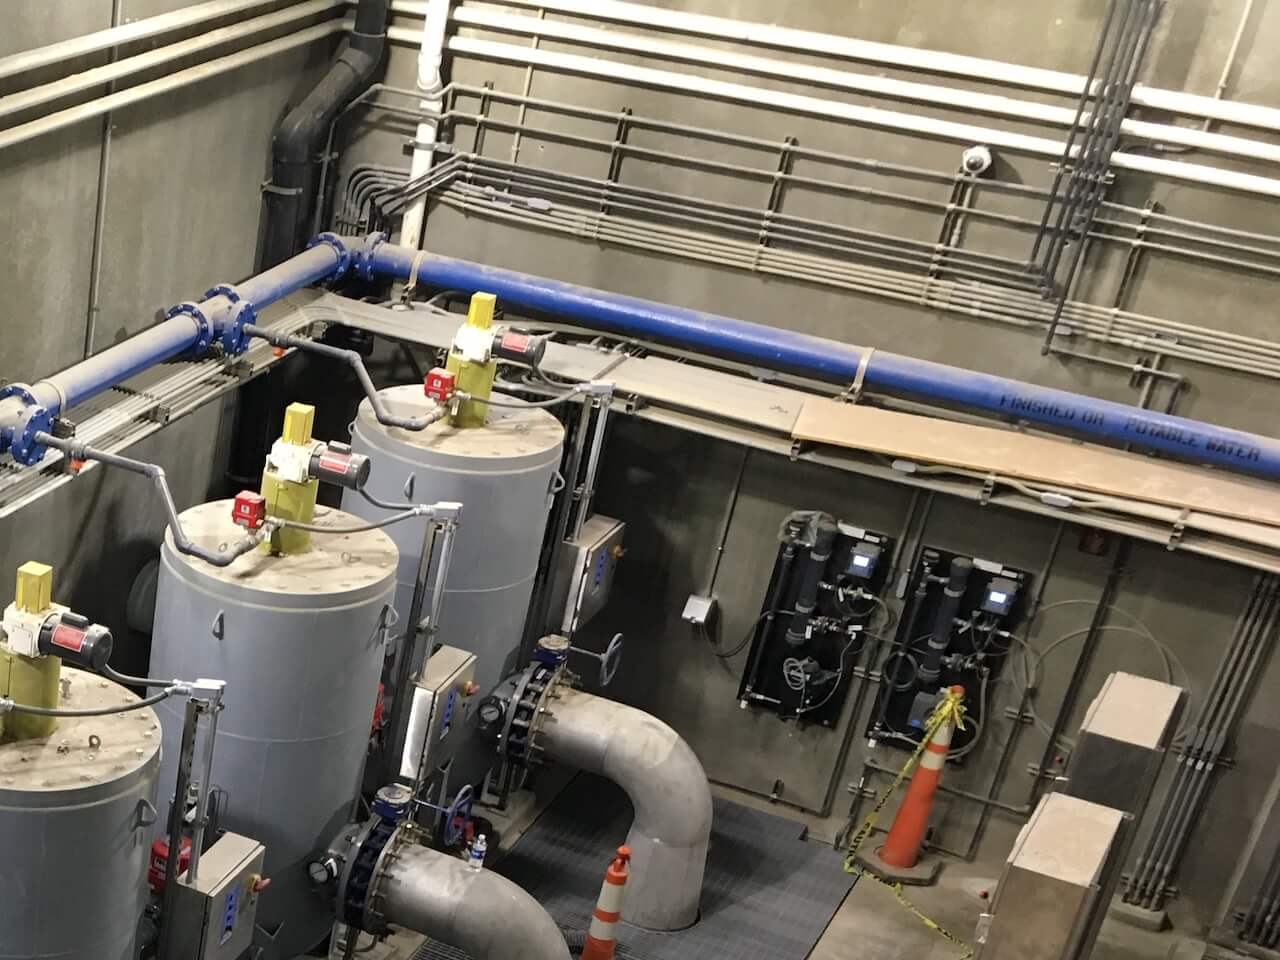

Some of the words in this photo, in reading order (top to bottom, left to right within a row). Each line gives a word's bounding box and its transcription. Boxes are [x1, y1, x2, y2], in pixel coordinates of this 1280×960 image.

[999, 394, 1075, 420] FINISHED
[1081, 410, 1105, 428] OR
[1123, 417, 1200, 449] POTABLE
[1205, 438, 1261, 464] WATER
